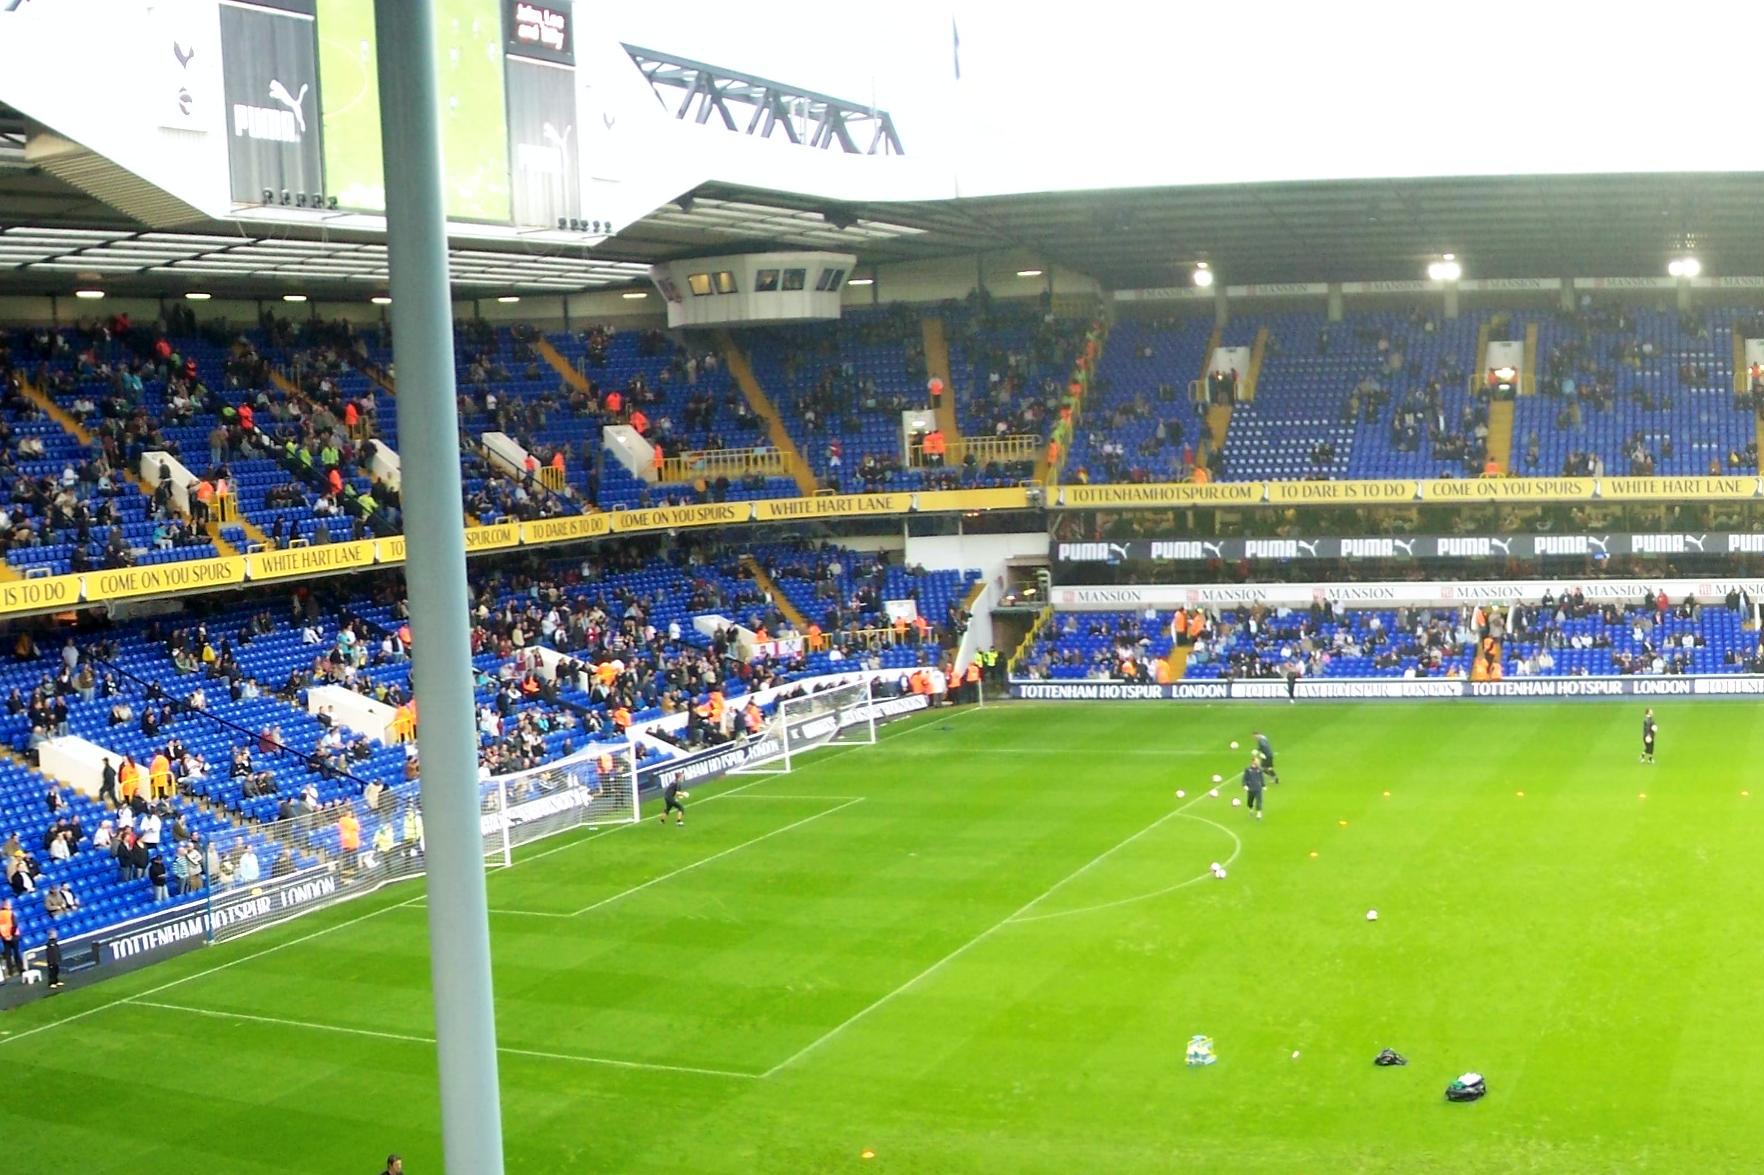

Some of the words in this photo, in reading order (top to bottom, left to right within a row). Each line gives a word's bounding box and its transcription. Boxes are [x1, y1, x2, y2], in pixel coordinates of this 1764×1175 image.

[233, 104, 297, 142] PUMA
[1491, 279, 1540, 288] MANSION
[1073, 485, 1252, 502] TOTTENHAMHOTSPUR.COM
[1281, 485, 1299, 498] TO
[1303, 484, 1338, 498] DARE
[1345, 484, 1357, 497] IS
[1361, 483, 1380, 496] TO
[1384, 483, 1405, 496] DO
[1433, 482, 1470, 496] COME
[1477, 482, 1498, 495] ON
[1503, 481, 1532, 494] YOU
[1536, 480, 1582, 494] SPURS
[1612, 479, 1657, 493] WHITE
[1663, 479, 1700, 493] HART
[1706, 479, 1742, 492] LANE
[771, 501, 813, 515] WHITE
[817, 499, 855, 513] HART
[858, 497, 893, 511] LANE
[621, 513, 650, 529] COME
[654, 511, 670, 526] ON
[672, 509, 694, 524] YOU
[696, 506, 735, 522] SPURS
[533, 525, 546, 539] TO
[546, 522, 568, 538] DARE
[570, 521, 578, 535] IS
[579, 520, 590, 534] TO
[590, 518, 603, 531] DO
[1059, 543, 1109, 560] PUMA
[1151, 542, 1201, 559] PUMA
[1246, 540, 1297, 557] PUMA
[1341, 539, 1393, 556] PUMA
[1437, 538, 1490, 555] PUMA
[1535, 537, 1587, 554] PUMA
[1632, 535, 1684, 552] PUMA
[262, 552, 298, 573] WHITE
[301, 549, 332, 569] HART
[335, 546, 362, 565] LANE
[100, 574, 136, 594] COME
[140, 571, 160, 590] ON
[163, 568, 189, 588] YOU
[192, 563, 232, 585] SPURS
[4, 589, 17, 606] IS
[20, 586, 39, 604] TO
[44, 583, 65, 601] DO
[1078, 591, 1141, 602] MANSION
[1202, 590, 1266, 601] MANSION
[1329, 588, 1394, 599] MANSION
[1457, 587, 1523, 598] MANSION
[1587, 585, 1652, 597] MANSION
[1020, 685, 1097, 698] TOTTENHAM
[1101, 685, 1162, 699] HOTSPUR
[1173, 684, 1226, 698] LONDON
[1472, 682, 1555, 696] TOTTENHAM
[1558, 681, 1622, 695] HOTSPUR
[1634, 680, 1689, 694] LONDON
[109, 916, 203, 960] TOTTENHAM
[204, 898, 271, 930] HOTSPUR
[281, 877, 335, 907] LONDON
